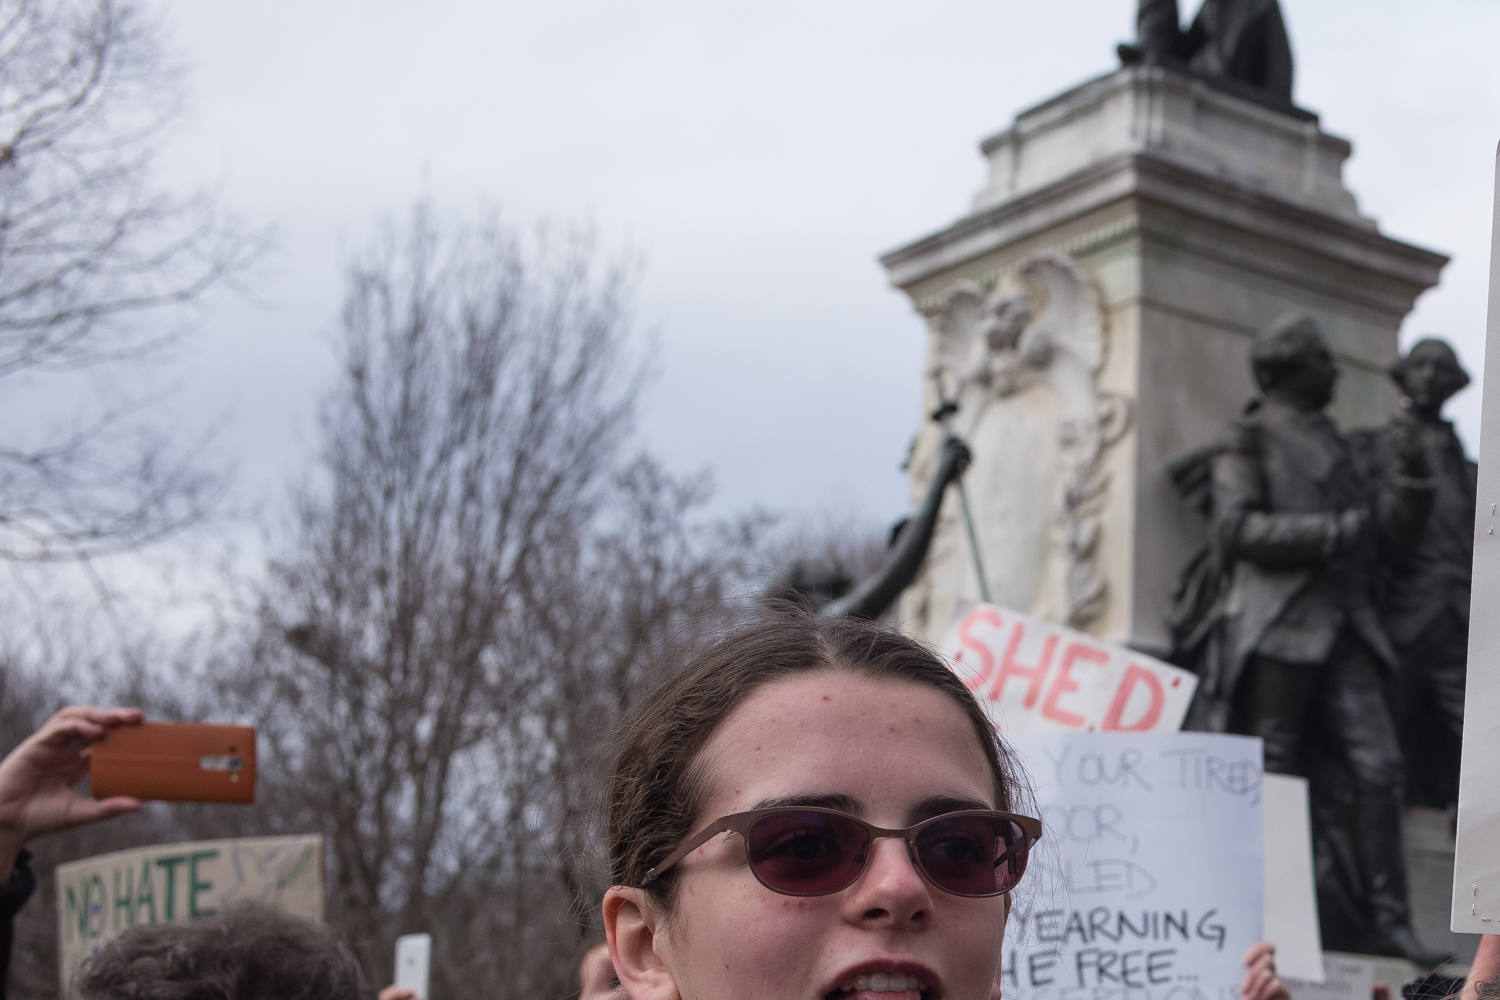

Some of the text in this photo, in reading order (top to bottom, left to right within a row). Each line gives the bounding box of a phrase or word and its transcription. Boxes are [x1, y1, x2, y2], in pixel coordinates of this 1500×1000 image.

[1043, 744, 1154, 792] YOUR
[1041, 802, 1140, 856] OOR,
[64, 850, 219, 943] NO HATE
[1010, 906, 1227, 951] YEARNING
